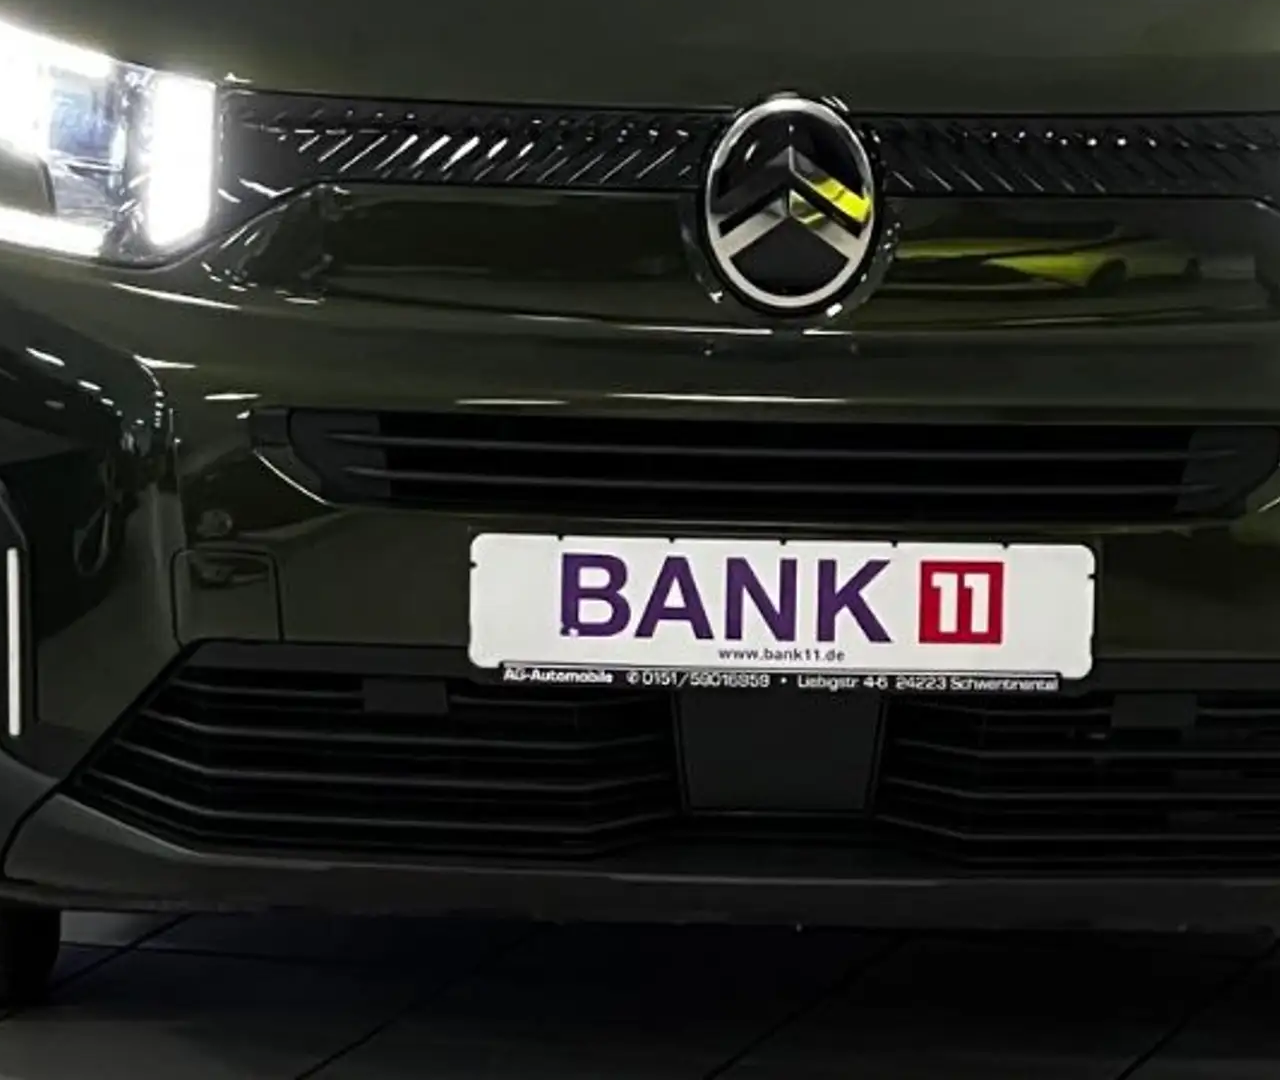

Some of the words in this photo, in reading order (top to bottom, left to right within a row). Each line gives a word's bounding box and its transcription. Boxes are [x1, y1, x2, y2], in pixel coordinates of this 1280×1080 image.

[559, 551, 891, 643] BANK
[929, 571, 991, 634] 11
[718, 647, 845, 662] www.bank11.de
[503, 667, 614, 684] AG-Automobile
[895, 675, 947, 691] 24223
